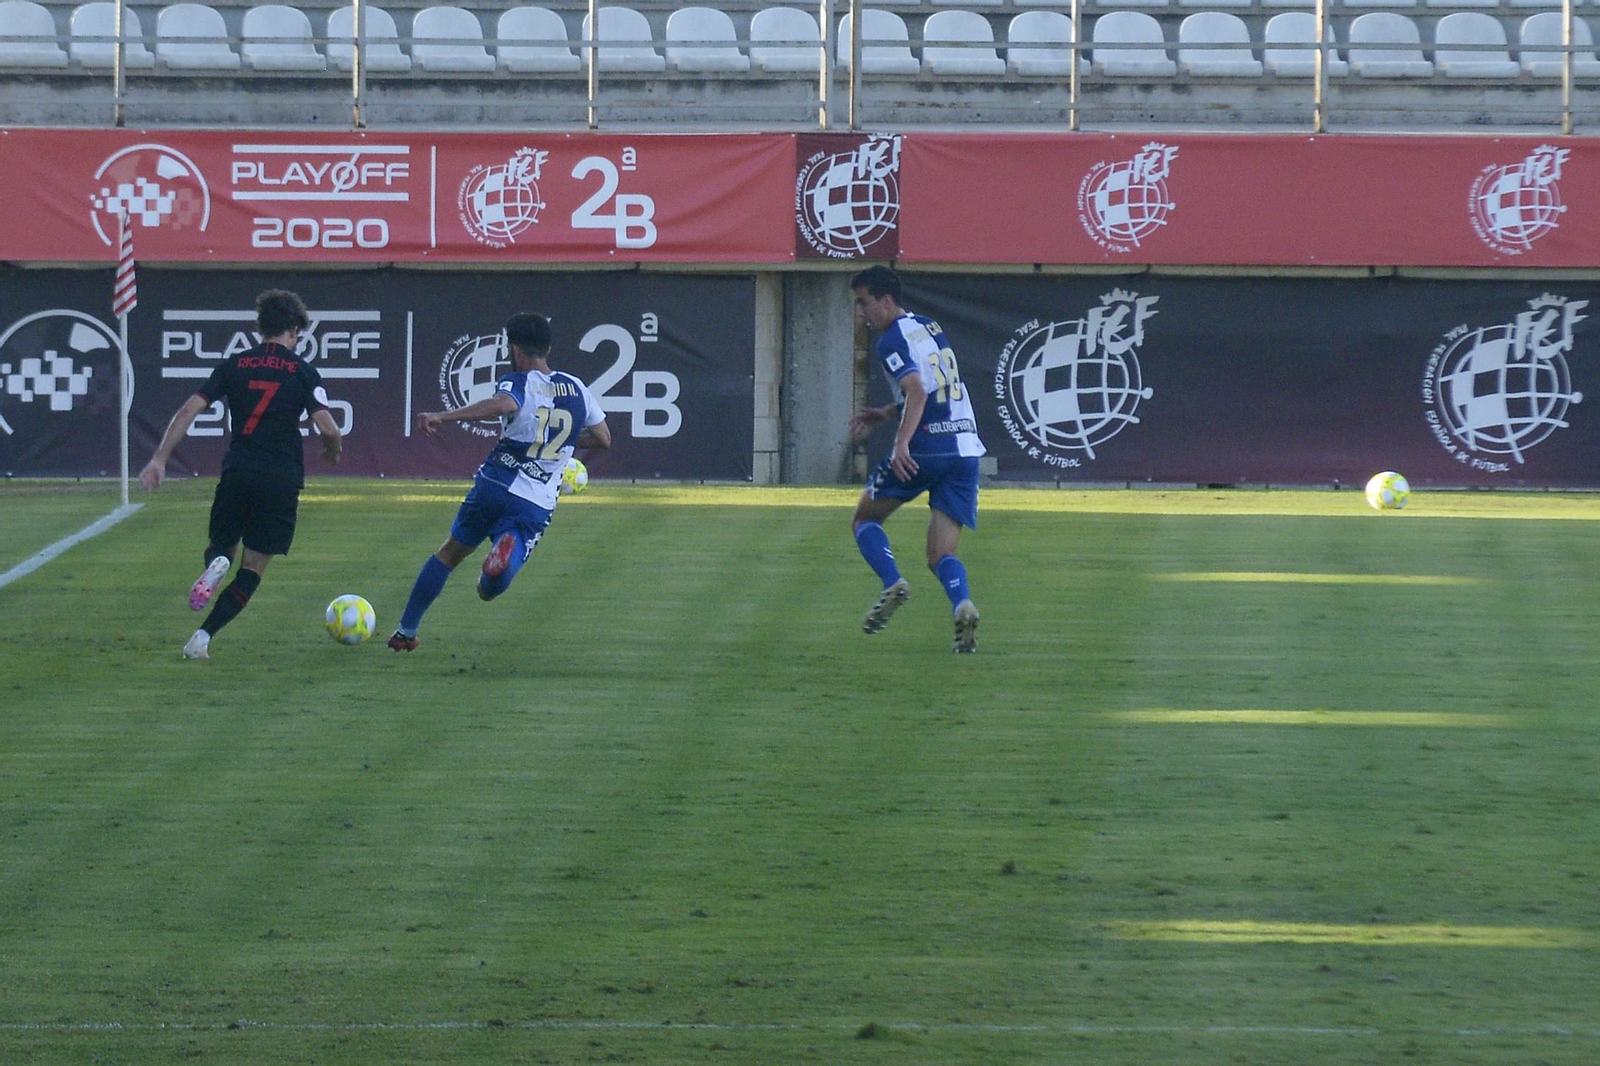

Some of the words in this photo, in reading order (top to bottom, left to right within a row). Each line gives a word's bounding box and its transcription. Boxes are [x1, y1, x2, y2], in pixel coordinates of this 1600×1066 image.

[232, 162, 410, 189] PLAYOFF
[252, 218, 389, 248] 2020
[1015, 317, 1040, 337] REAL
[238, 355, 298, 373] RIQUELME
[927, 347, 963, 404] 18
[241, 380, 281, 435] 7
[525, 406, 573, 461] 12
[997, 404, 1030, 450] ESPAÑOLA
[1027, 446, 1042, 460] DE
